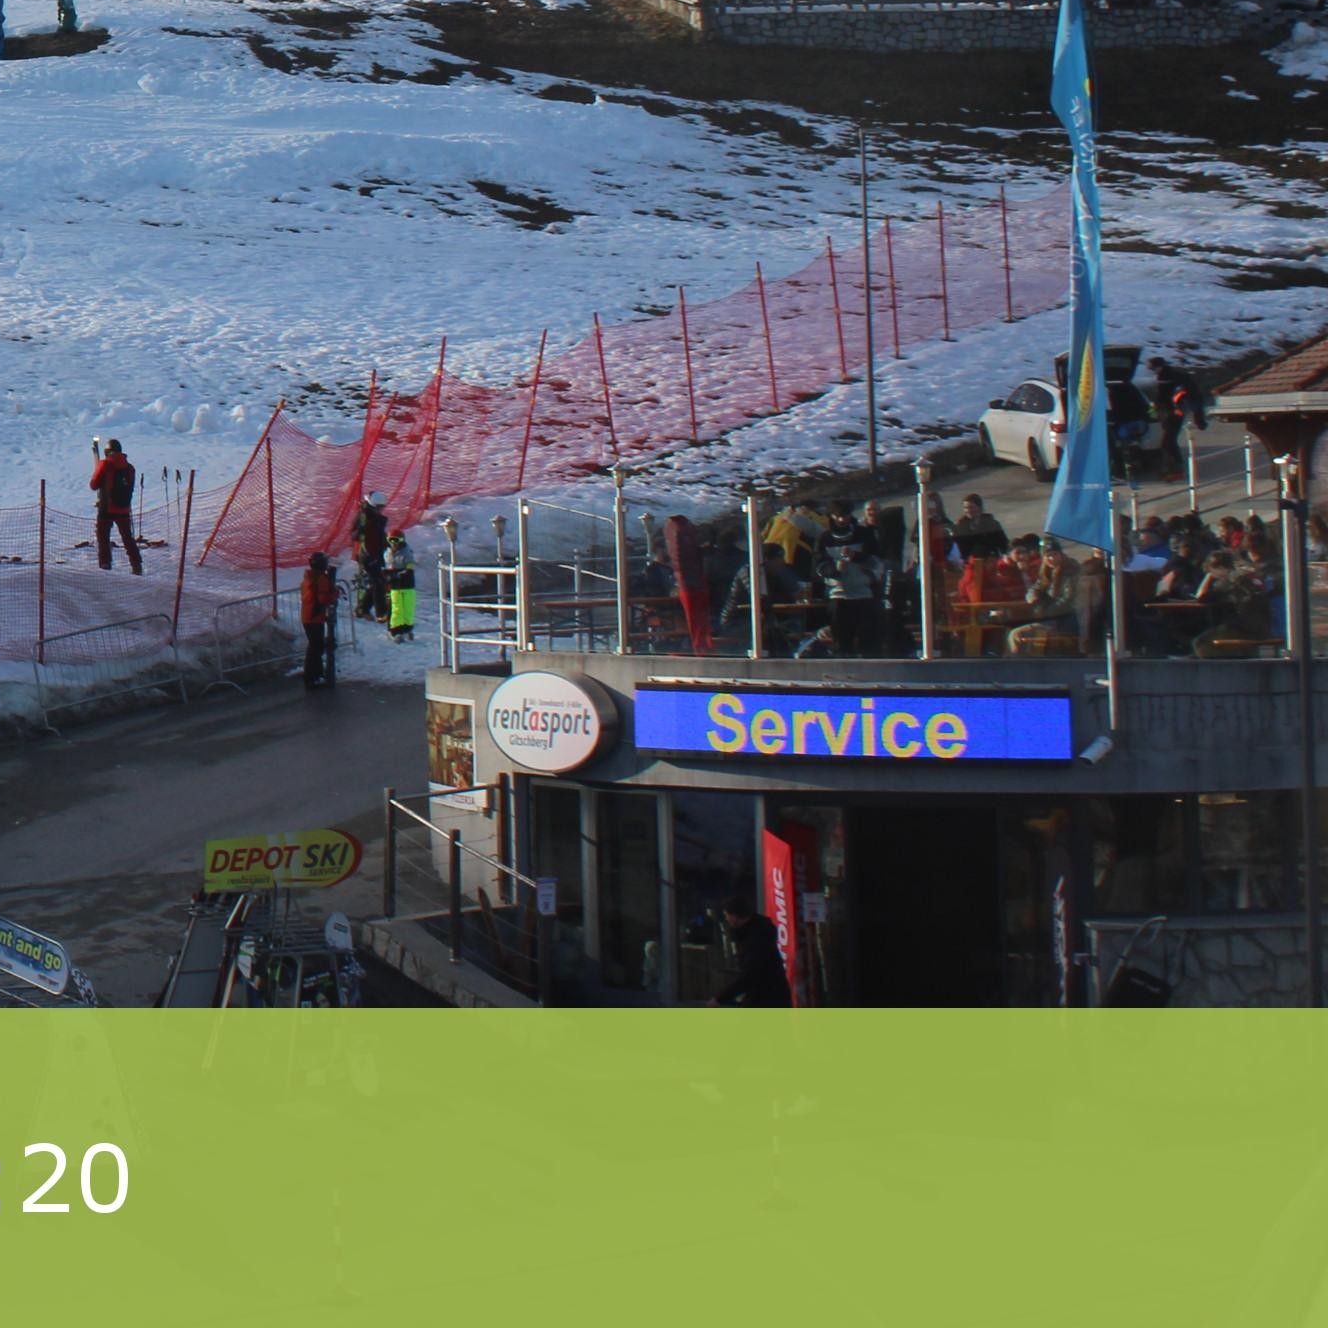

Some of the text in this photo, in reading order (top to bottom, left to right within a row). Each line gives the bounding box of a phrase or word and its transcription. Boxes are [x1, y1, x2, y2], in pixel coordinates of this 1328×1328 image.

[492, 698, 591, 749] rentasport
[706, 692, 968, 759] Service
[209, 842, 350, 873] DEPOT SKI
[15, 938, 43, 961] and
[44, 952, 62, 970] go
